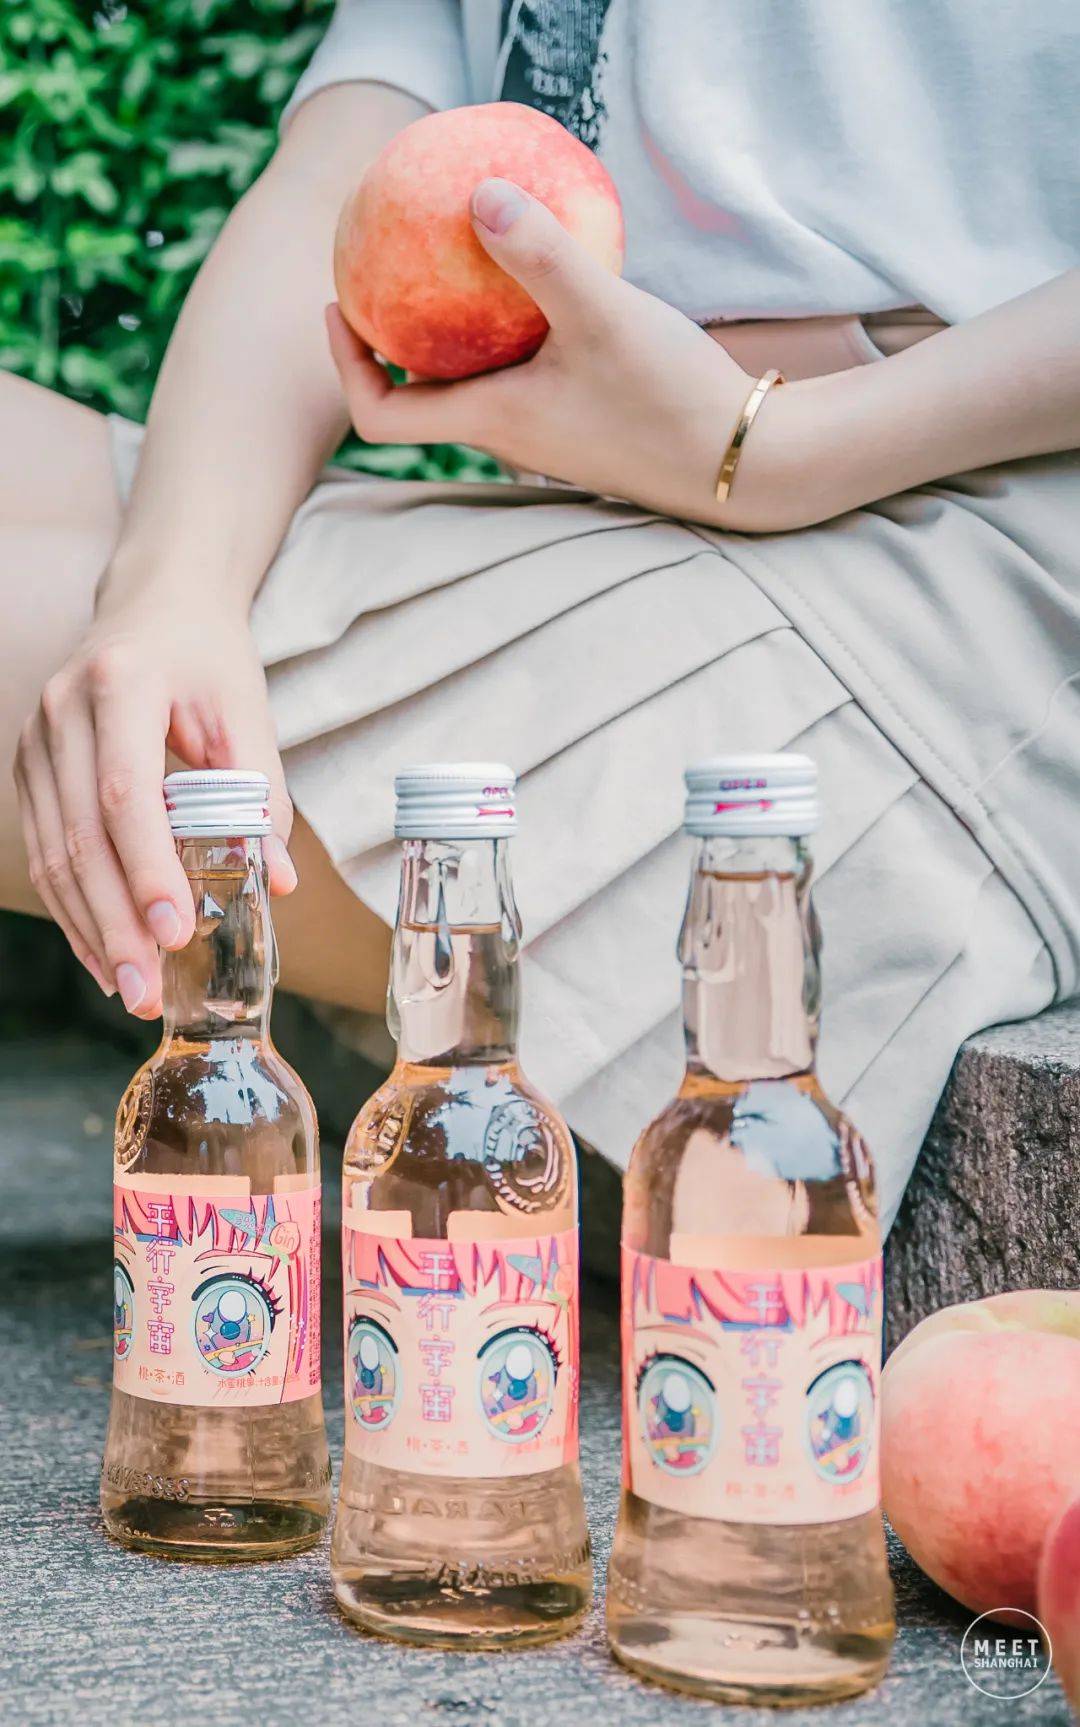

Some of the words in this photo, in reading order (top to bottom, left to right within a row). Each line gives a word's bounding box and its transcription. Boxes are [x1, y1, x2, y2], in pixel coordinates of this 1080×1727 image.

[146, 1203, 176, 1355] 平行宇宙
[274, 1225, 296, 1250] Gin
[417, 1252, 456, 1422] 平行宇宙
